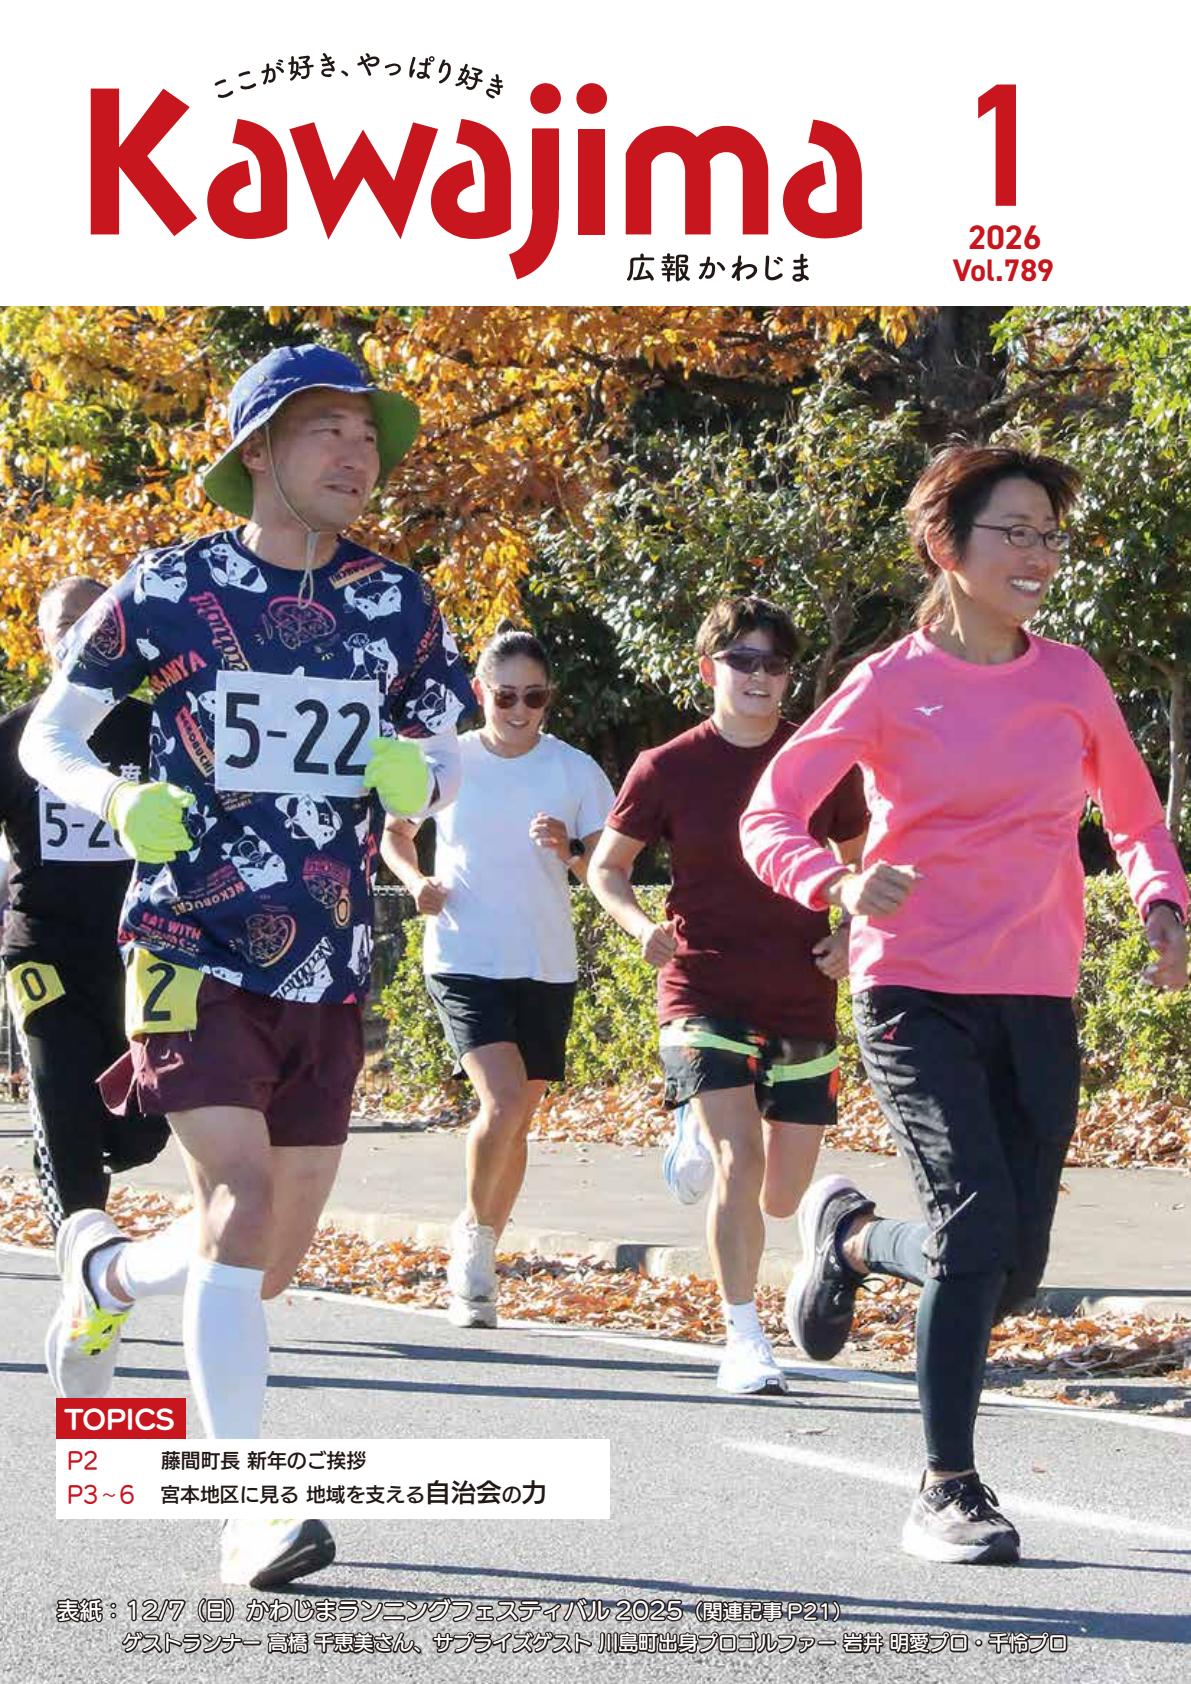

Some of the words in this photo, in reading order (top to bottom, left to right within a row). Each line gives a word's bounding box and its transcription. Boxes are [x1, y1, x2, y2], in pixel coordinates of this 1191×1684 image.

[225, 692, 371, 776] 5-22
[45, 802, 123, 848] 5-2
[20, 967, 47, 1001] 0
[143, 962, 177, 1022] 2
